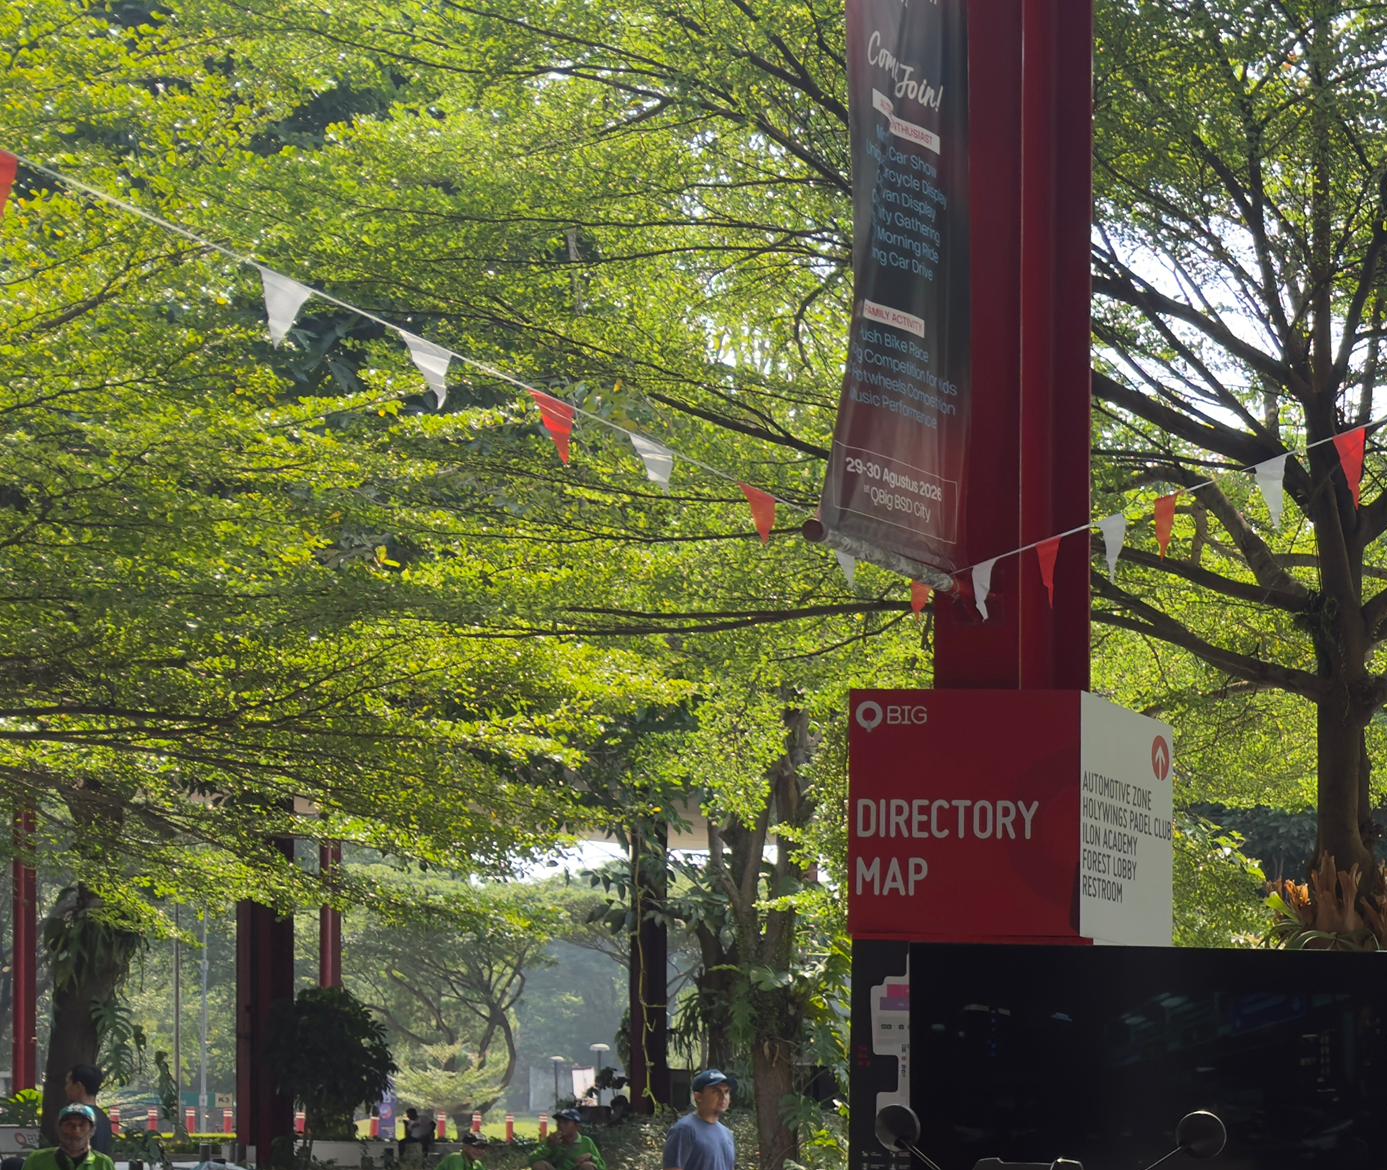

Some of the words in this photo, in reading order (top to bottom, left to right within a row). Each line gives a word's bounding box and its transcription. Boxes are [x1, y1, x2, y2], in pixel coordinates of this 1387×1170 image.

[894, 63, 943, 112] Join!
[888, 146, 909, 167] Car
[909, 154, 937, 179] Show
[901, 193, 937, 222] Display
[921, 179, 948, 211] Display
[894, 211, 941, 247] Gathering
[888, 251, 910, 270] Car
[911, 258, 934, 281] Drive
[891, 312, 923, 334] ACTIVITY
[883, 332, 908, 353] Bike
[846, 457, 881, 480] 29-30
[882, 467, 919, 495] Agustus
[870, 486, 895, 512] QBig
[894, 494, 913, 514] BSD
[913, 501, 932, 523] City
[1082, 770, 1131, 805] AUTOMOTIVE
[1132, 785, 1152, 812] ZONE
[856, 798, 1040, 840] DIRECTORY
[1082, 796, 1128, 829] HOLYWINGS
[1129, 809, 1153, 836] PADEL
[1153, 817, 1172, 841] CLUB
[1082, 822, 1101, 847] ILON
[1102, 827, 1138, 857] ACADEMY
[855, 856, 929, 897] MAP
[1082, 848, 1112, 876] FOREST
[1112, 856, 1137, 881] LOBBY
[1082, 874, 1123, 904] RESTROOM
